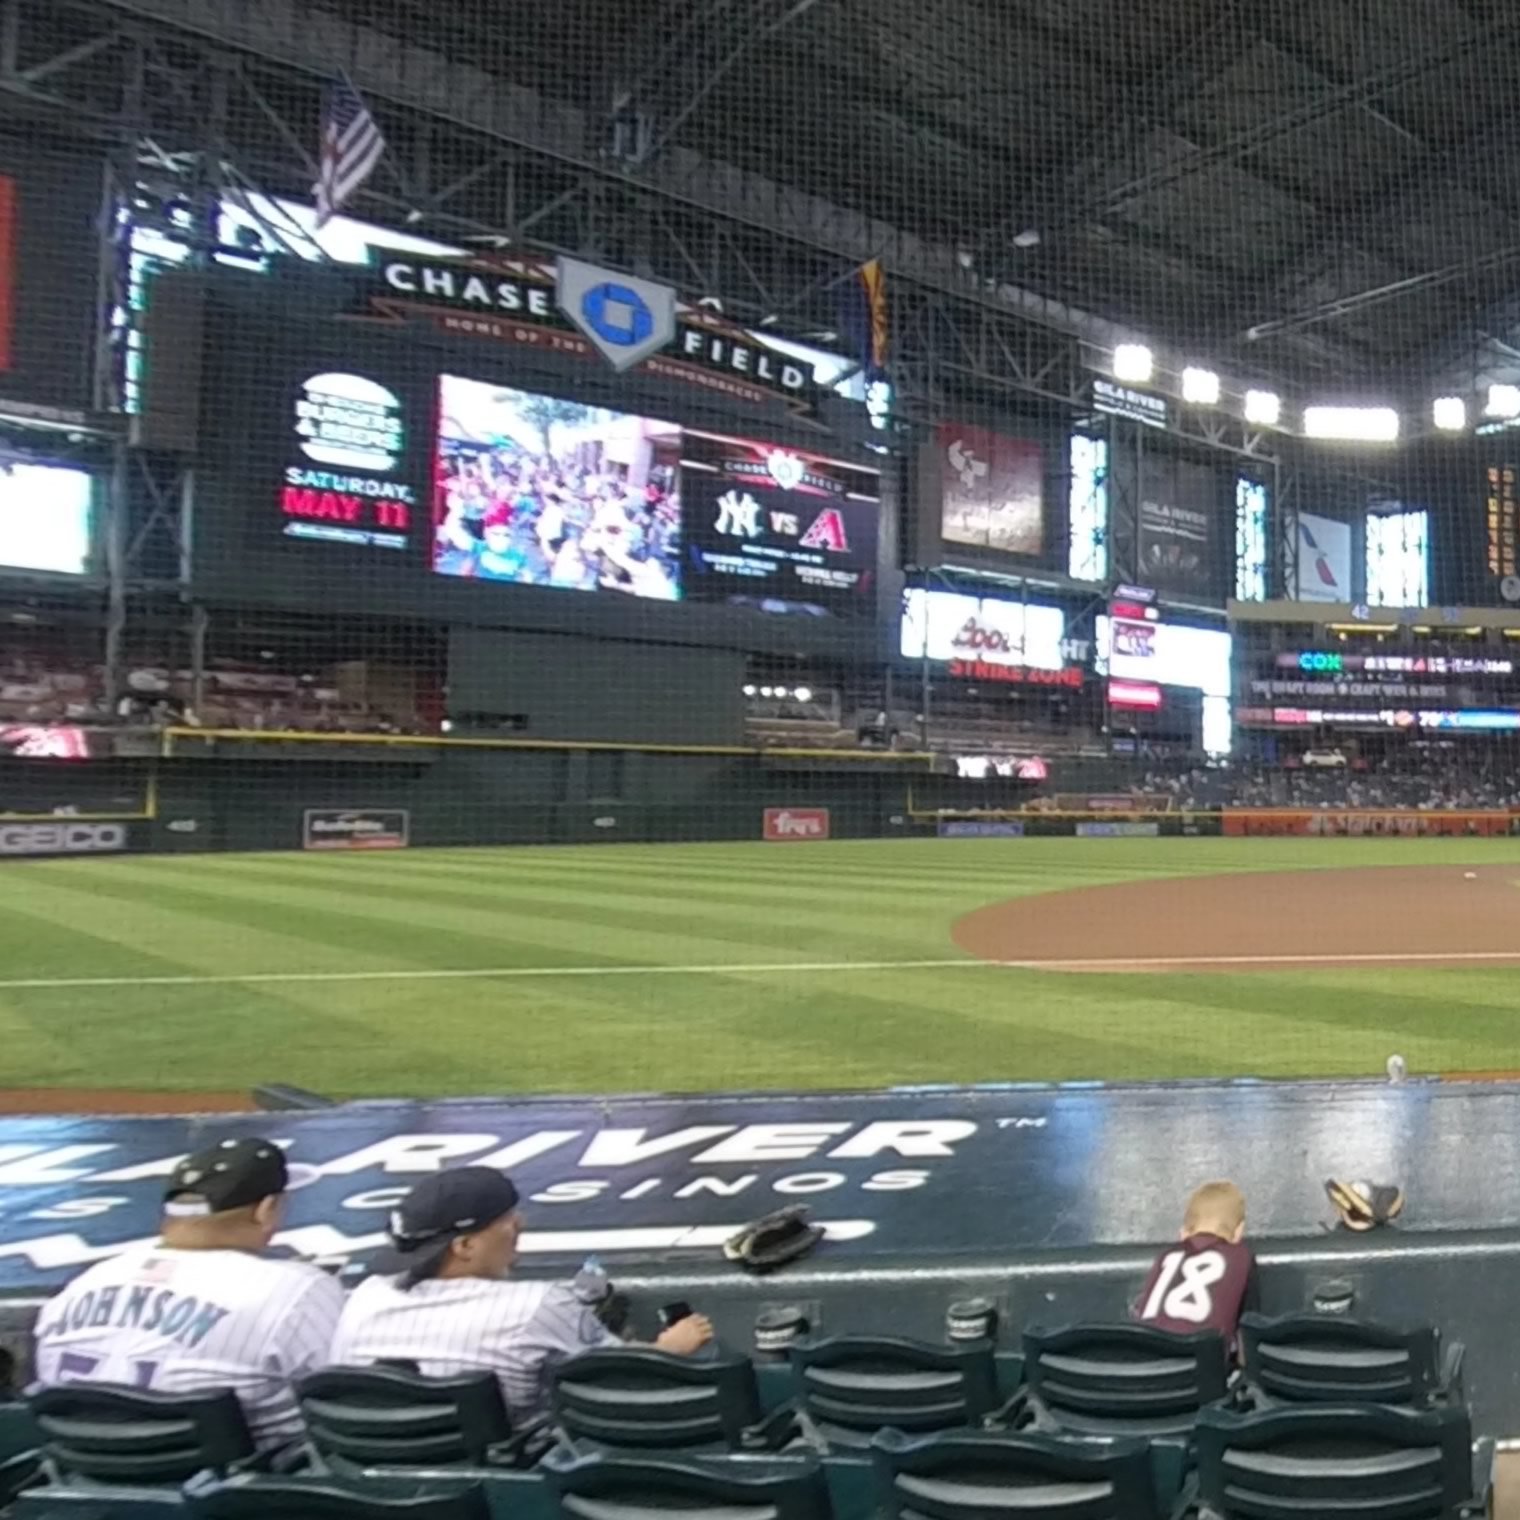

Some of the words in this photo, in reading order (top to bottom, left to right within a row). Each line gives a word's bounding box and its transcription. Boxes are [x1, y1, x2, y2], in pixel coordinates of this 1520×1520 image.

[384, 263, 549, 316] CHASE
[684, 331, 804, 389] FIELD
[445, 317, 501, 337] HOME
[514, 329, 540, 343] OF
[552, 336, 586, 353] THE
[279, 486, 365, 522] MAY
[373, 499, 411, 529] 11
[949, 657, 1023, 683] STRIKE
[1027, 666, 1084, 689] ZONE
[1300, 651, 1342, 670] COX
[2, 824, 123, 850] GEICO
[320, 1120, 978, 1173] RIVER
[1141, 1250, 1227, 1323] 18
[46, 1283, 231, 1349] JOHNSON
